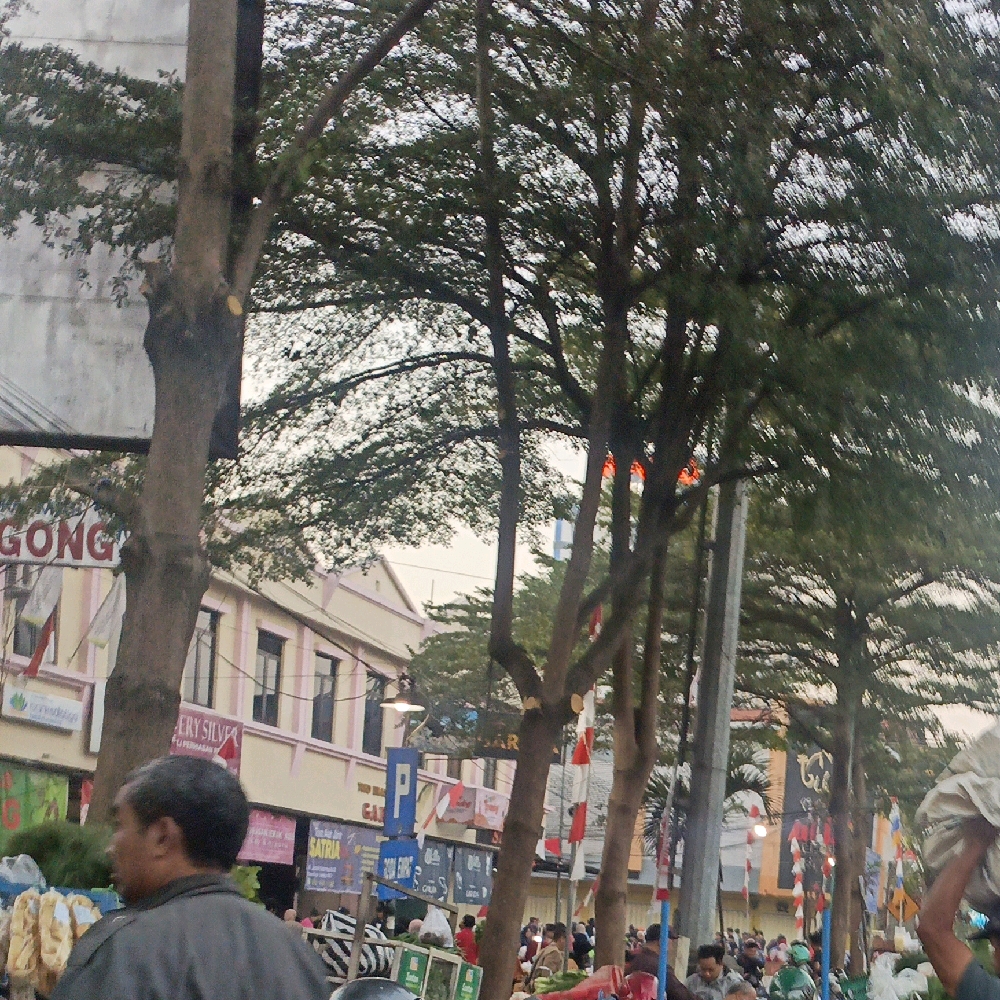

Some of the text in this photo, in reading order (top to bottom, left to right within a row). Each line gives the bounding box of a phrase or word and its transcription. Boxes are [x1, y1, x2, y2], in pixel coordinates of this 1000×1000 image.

[174, 714, 201, 738] ERY
[394, 763, 411, 819] P
[309, 836, 340, 860] SATRIA
